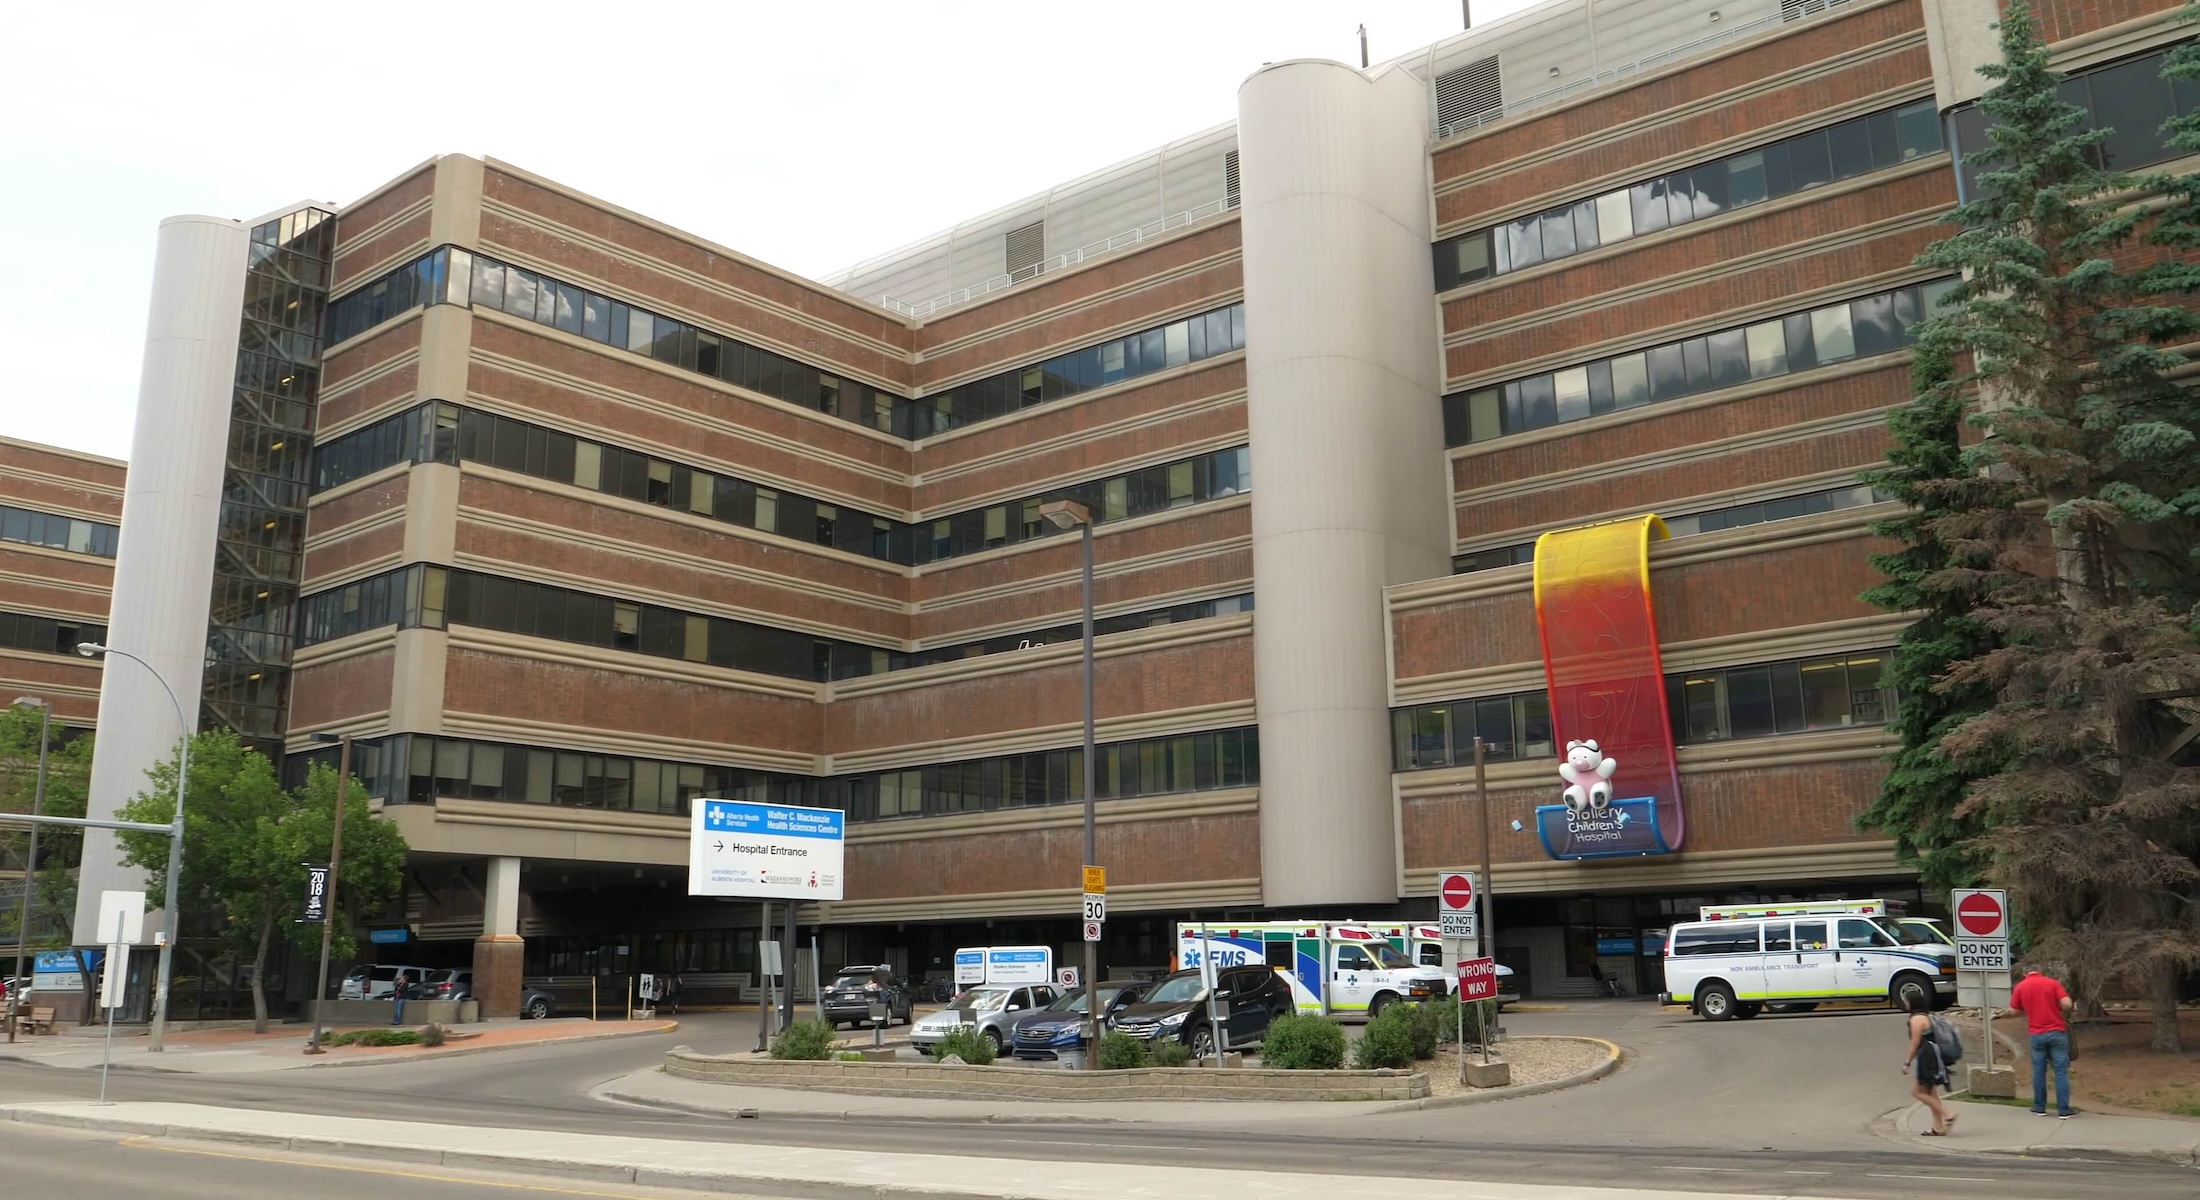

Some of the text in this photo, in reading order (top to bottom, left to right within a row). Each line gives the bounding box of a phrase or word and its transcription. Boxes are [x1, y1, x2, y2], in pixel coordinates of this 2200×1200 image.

[726, 812, 760, 822] Alberta Health
[767, 810, 830, 824] Walter C. Mackenzie
[1566, 807, 1623, 822] Stollery
[726, 819, 748, 828] Services
[767, 820, 839, 835] Health Sciences Centre
[1568, 820, 1624, 833] Children's
[1575, 831, 1622, 843] Hospital
[732, 842, 808, 857] Hospital Entrance
[311, 872, 324, 883] 20
[310, 883, 323, 895] 18
[1086, 902, 1103, 919] 30
[1442, 915, 1472, 925] DO NOT
[1444, 925, 1472, 935] ENTER
[1960, 943, 2004, 955] DO NOT
[1209, 950, 1246, 967] EMS
[1963, 956, 2003, 967] ENTER
[1457, 962, 1493, 979] WRONG
[1745, 964, 1781, 972] AMBULANCE
[1467, 981, 1487, 995] WAY
